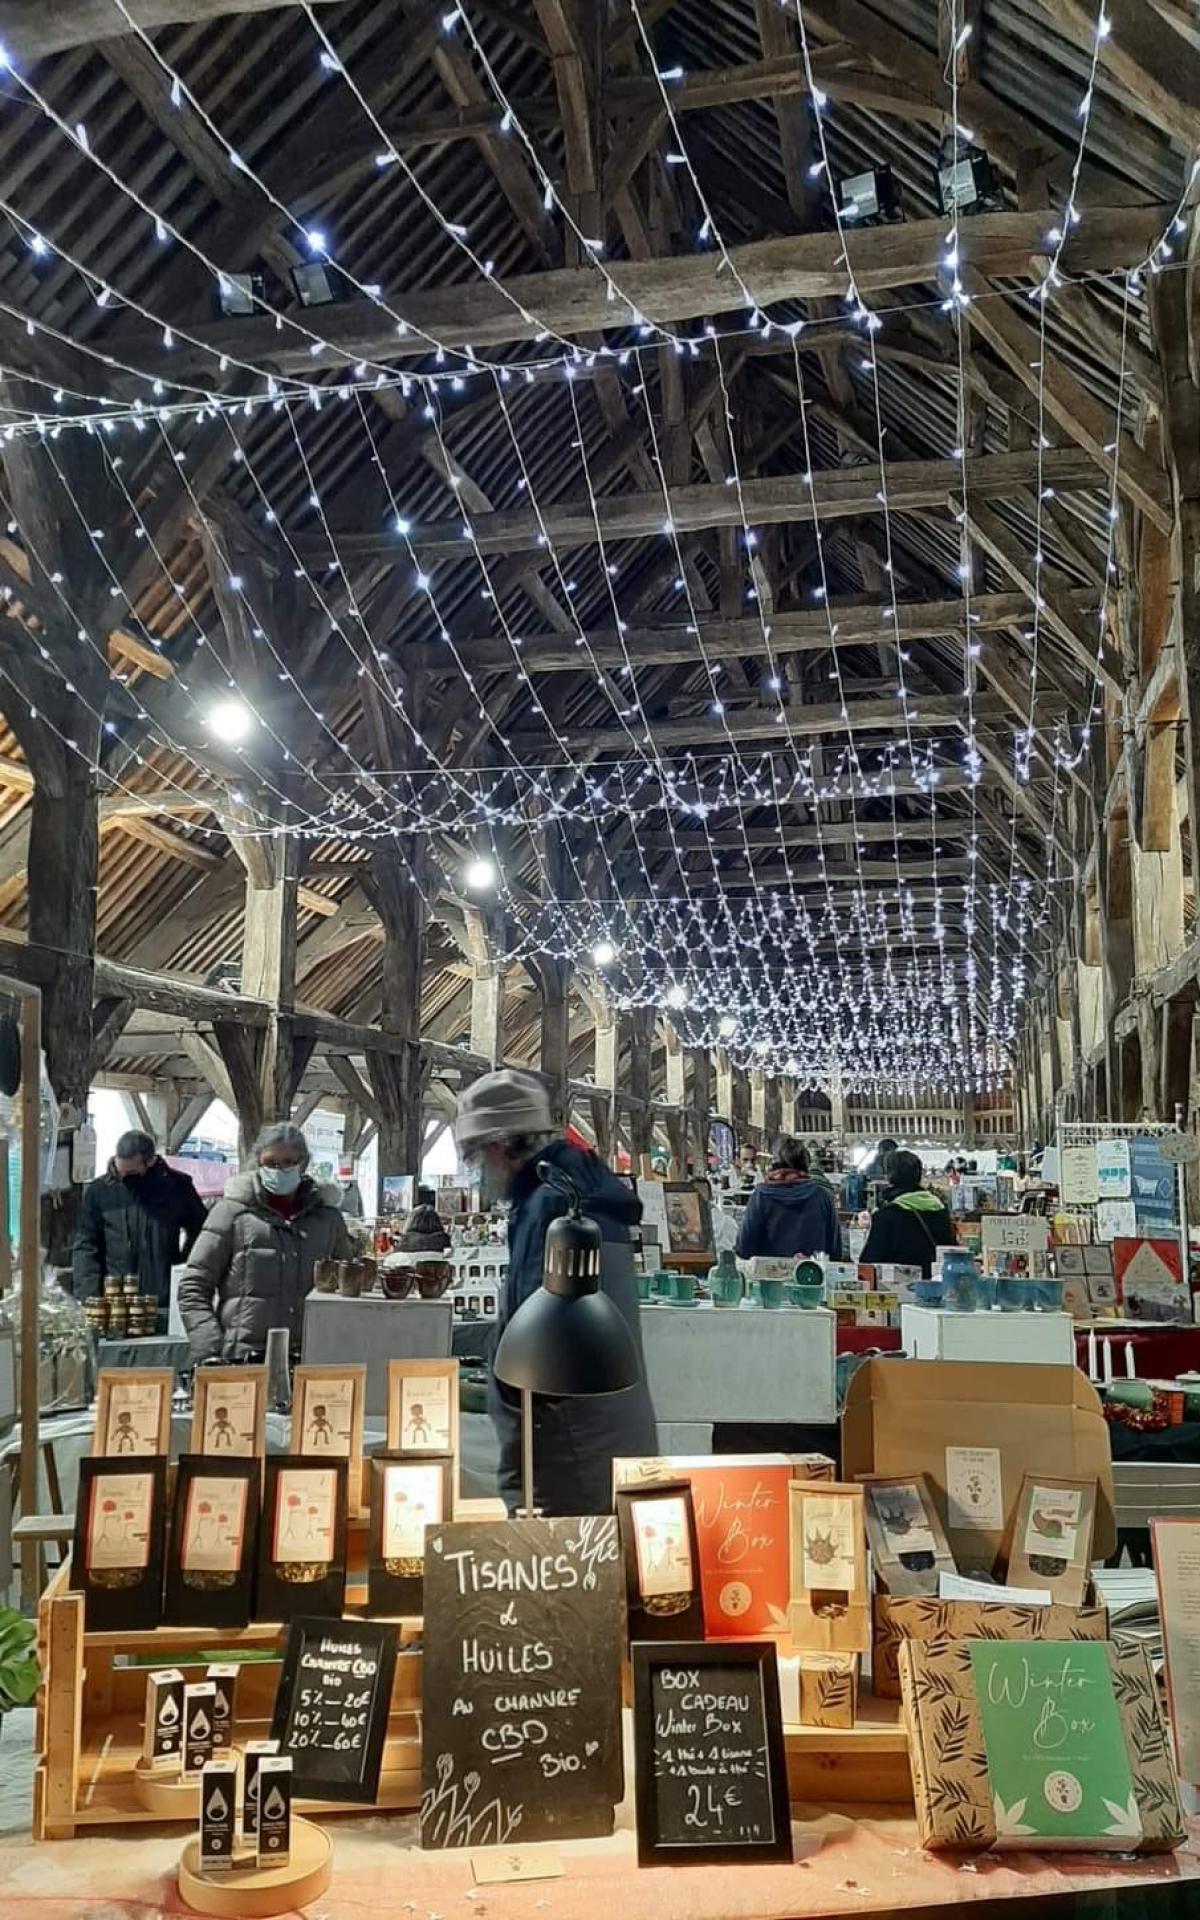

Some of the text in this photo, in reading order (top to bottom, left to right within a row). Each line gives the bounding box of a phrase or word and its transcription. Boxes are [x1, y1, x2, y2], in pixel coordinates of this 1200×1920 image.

[717, 1516, 775, 1564] Box
[352, 1658, 377, 1676] CBD
[661, 1668, 700, 1689] BOX
[988, 1657, 1096, 1708] Winter
[494, 1688, 582, 1713] CHANVRE
[680, 1693, 749, 1711] CADEAU
[481, 1719, 548, 1751] CBD
[1033, 1696, 1096, 1749] Box
